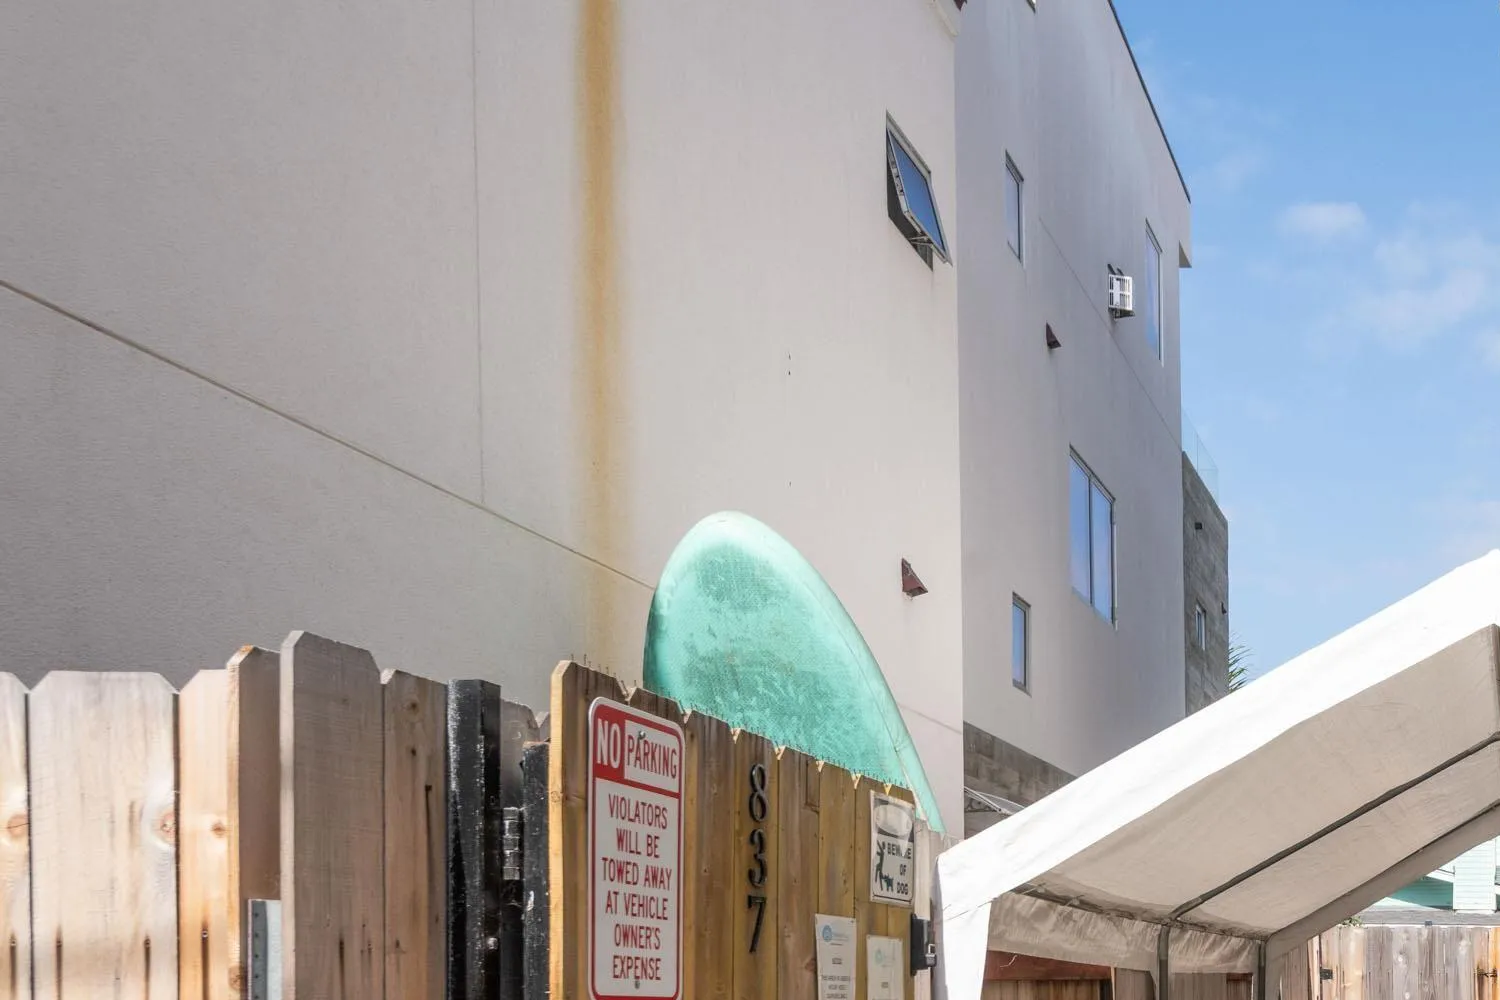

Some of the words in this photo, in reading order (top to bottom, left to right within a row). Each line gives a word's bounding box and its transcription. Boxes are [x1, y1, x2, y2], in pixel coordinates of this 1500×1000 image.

[597, 718, 621, 769] NO
[627, 735, 677, 779] PARKING
[608, 793, 668, 830] VIOLATORS
[616, 827, 642, 855] WILL
[646, 834, 660, 858] BE
[887, 842, 912, 859] BEWE
[748, 763, 769, 954] 837
[900, 864, 907, 876] OF
[602, 857, 639, 886] TOWED
[644, 864, 672, 891] AWAY
[897, 882, 908, 895] DOG
[605, 890, 619, 914] AT
[624, 893, 668, 920] VEHICLE
[614, 923, 661, 950] OWNER'S
[612, 955, 661, 981] EXPENSE
